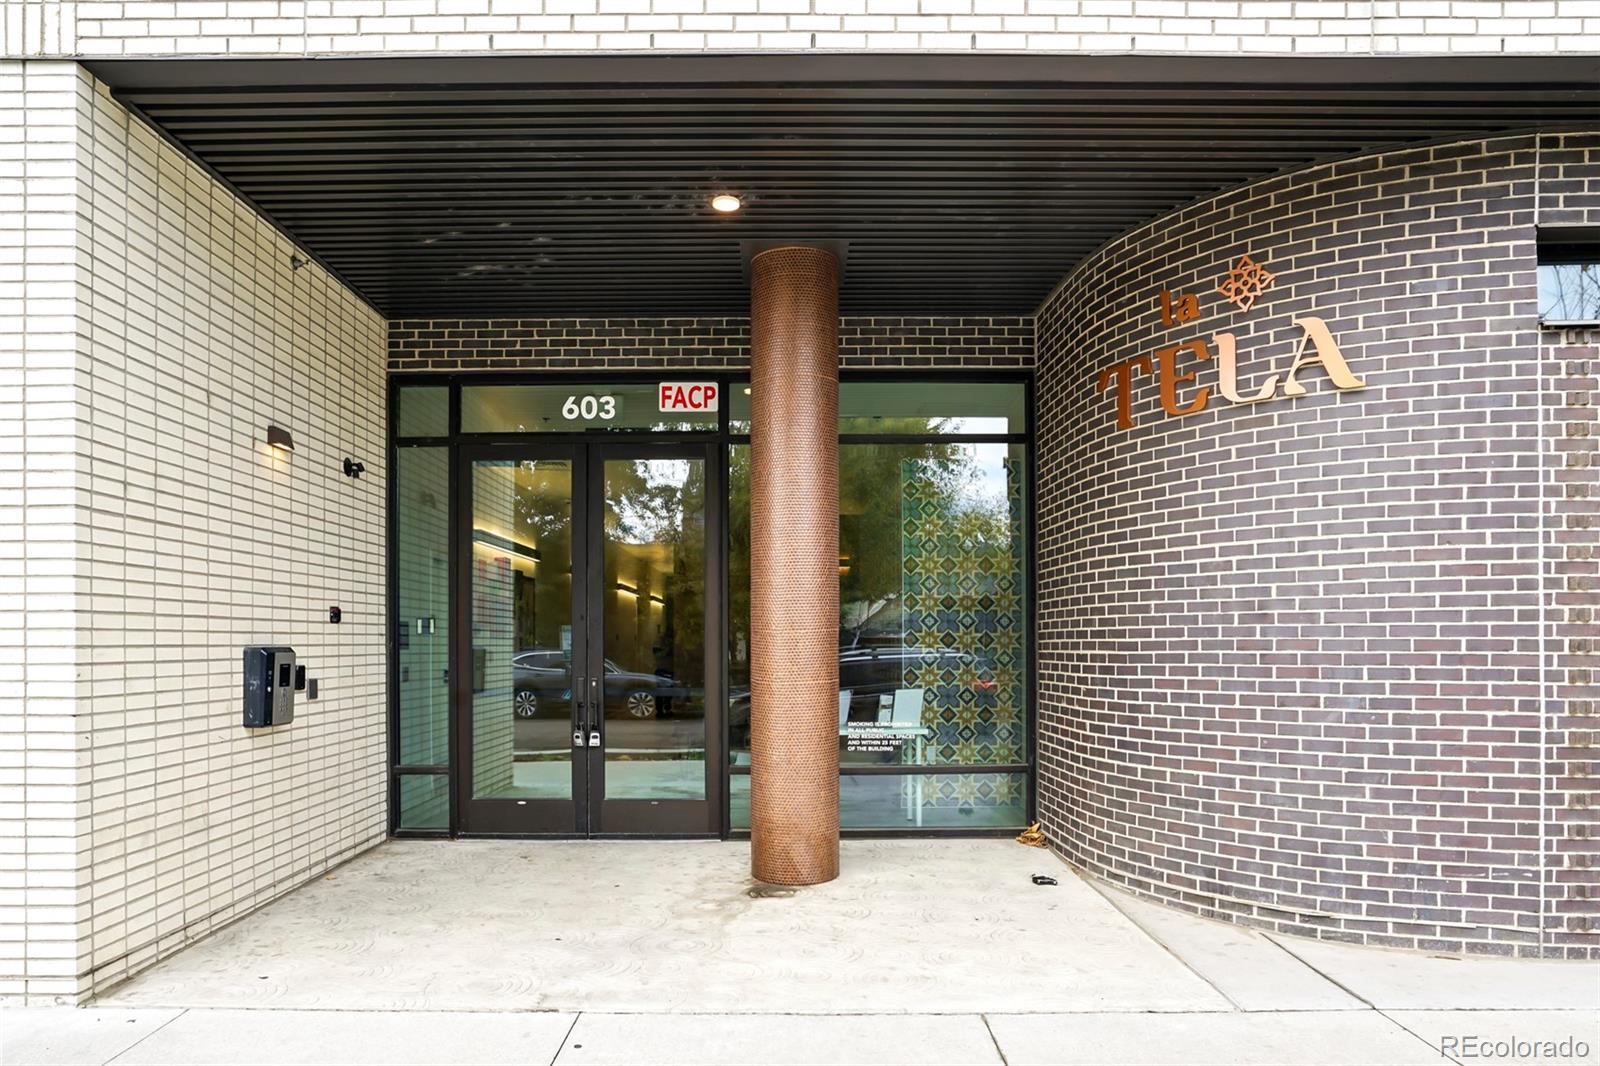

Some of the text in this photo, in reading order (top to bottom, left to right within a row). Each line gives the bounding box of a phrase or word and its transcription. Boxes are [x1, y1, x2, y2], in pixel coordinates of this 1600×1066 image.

[1159, 290, 1202, 327] la
[1097, 316, 1367, 430] TELA
[561, 395, 616, 420] 603
[661, 385, 717, 409] FACP
